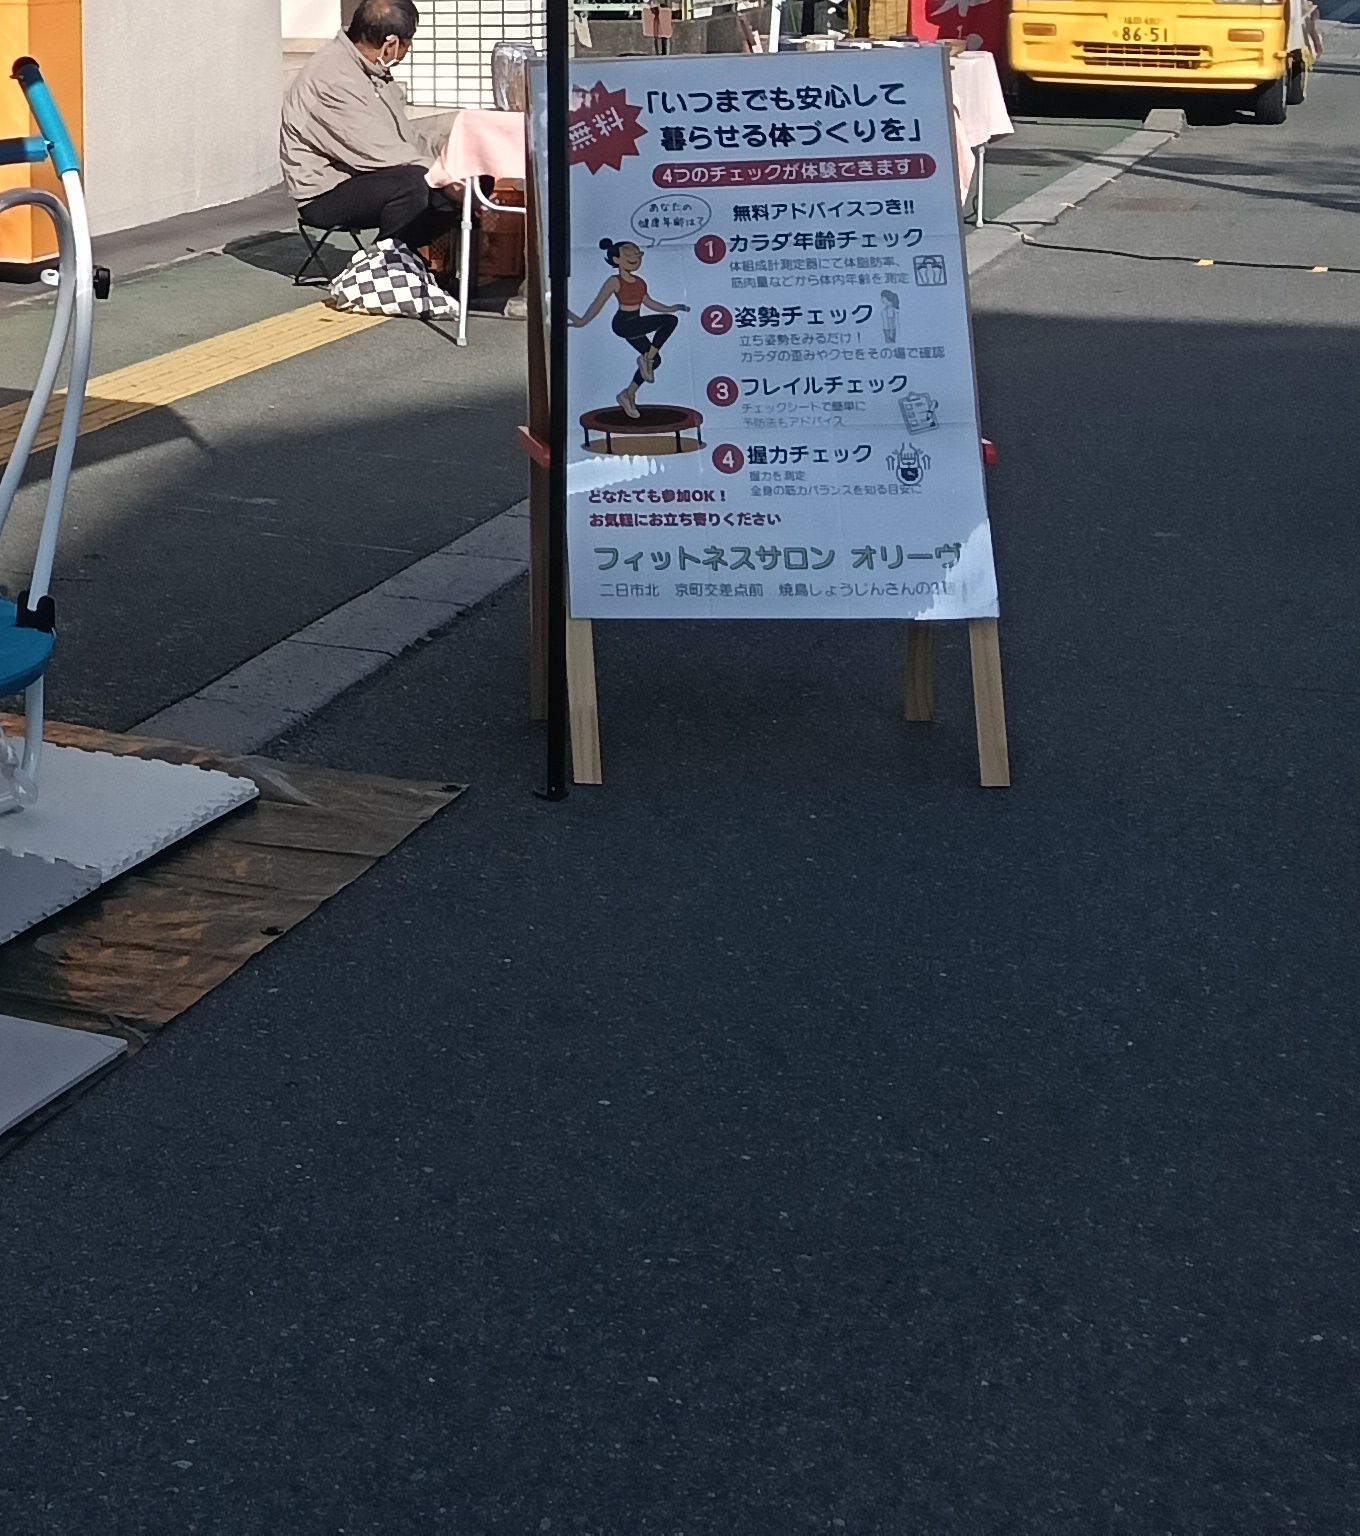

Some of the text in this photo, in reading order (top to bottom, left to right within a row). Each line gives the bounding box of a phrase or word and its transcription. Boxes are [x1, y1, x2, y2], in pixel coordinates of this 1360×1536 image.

[646, 82, 907, 114] 「いつまでも安心して
[567, 106, 625, 153] 無料
[648, 202, 693, 213] あなたの
[729, 228, 923, 253] カラダ年齢チェック
[734, 304, 874, 329] 姿勢チェック
[741, 374, 908, 397] フレイルチェック
[741, 400, 867, 414] チェックシートで簡単に
[746, 444, 873, 466] 握力チェック
[749, 469, 806, 482] 握力を測定
[588, 512, 782, 528] お気軽にお立ち寄りください
[593, 542, 962, 572] フィットネスサロン オリーヴ
[600, 583, 660, 598] 二日市北
[675, 583, 765, 598] 京町交差点前
